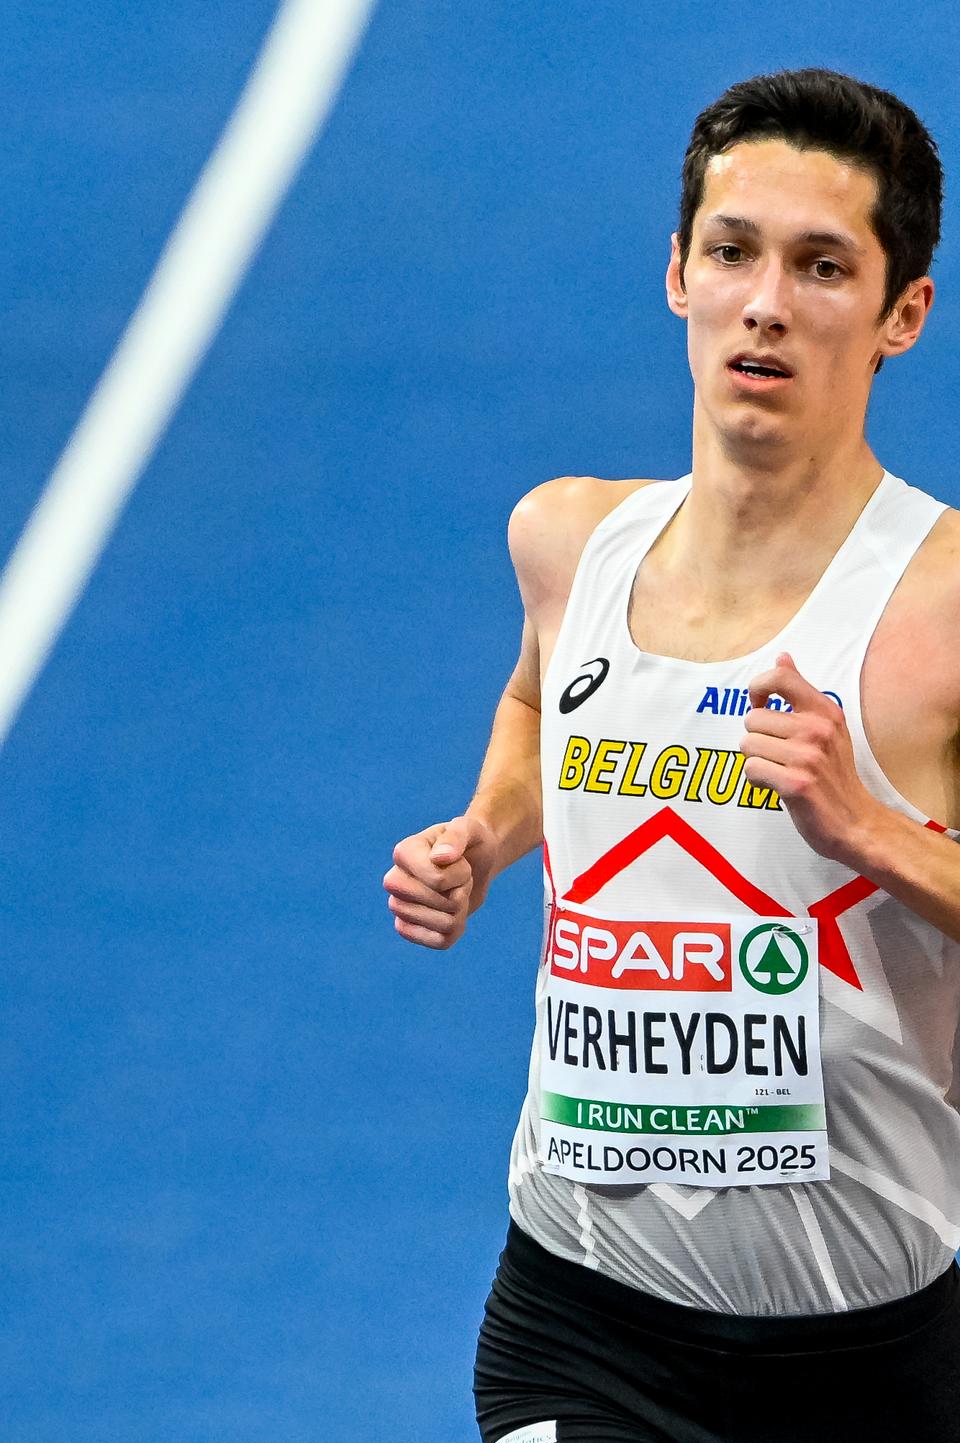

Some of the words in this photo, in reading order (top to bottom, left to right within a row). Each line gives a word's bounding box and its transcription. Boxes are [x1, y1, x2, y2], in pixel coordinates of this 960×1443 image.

[696, 686, 796, 717] Allin
[552, 918, 725, 982] SPAR
[547, 995, 808, 1076] VERHEYDEN
[755, 1088, 769, 1096] 121
[776, 1088, 791, 1096] BEL
[576, 1102, 583, 1124] I
[588, 1103, 643, 1130] RUN
[547, 1136, 727, 1174] APELDOORN
[736, 1144, 817, 1172] 2025
